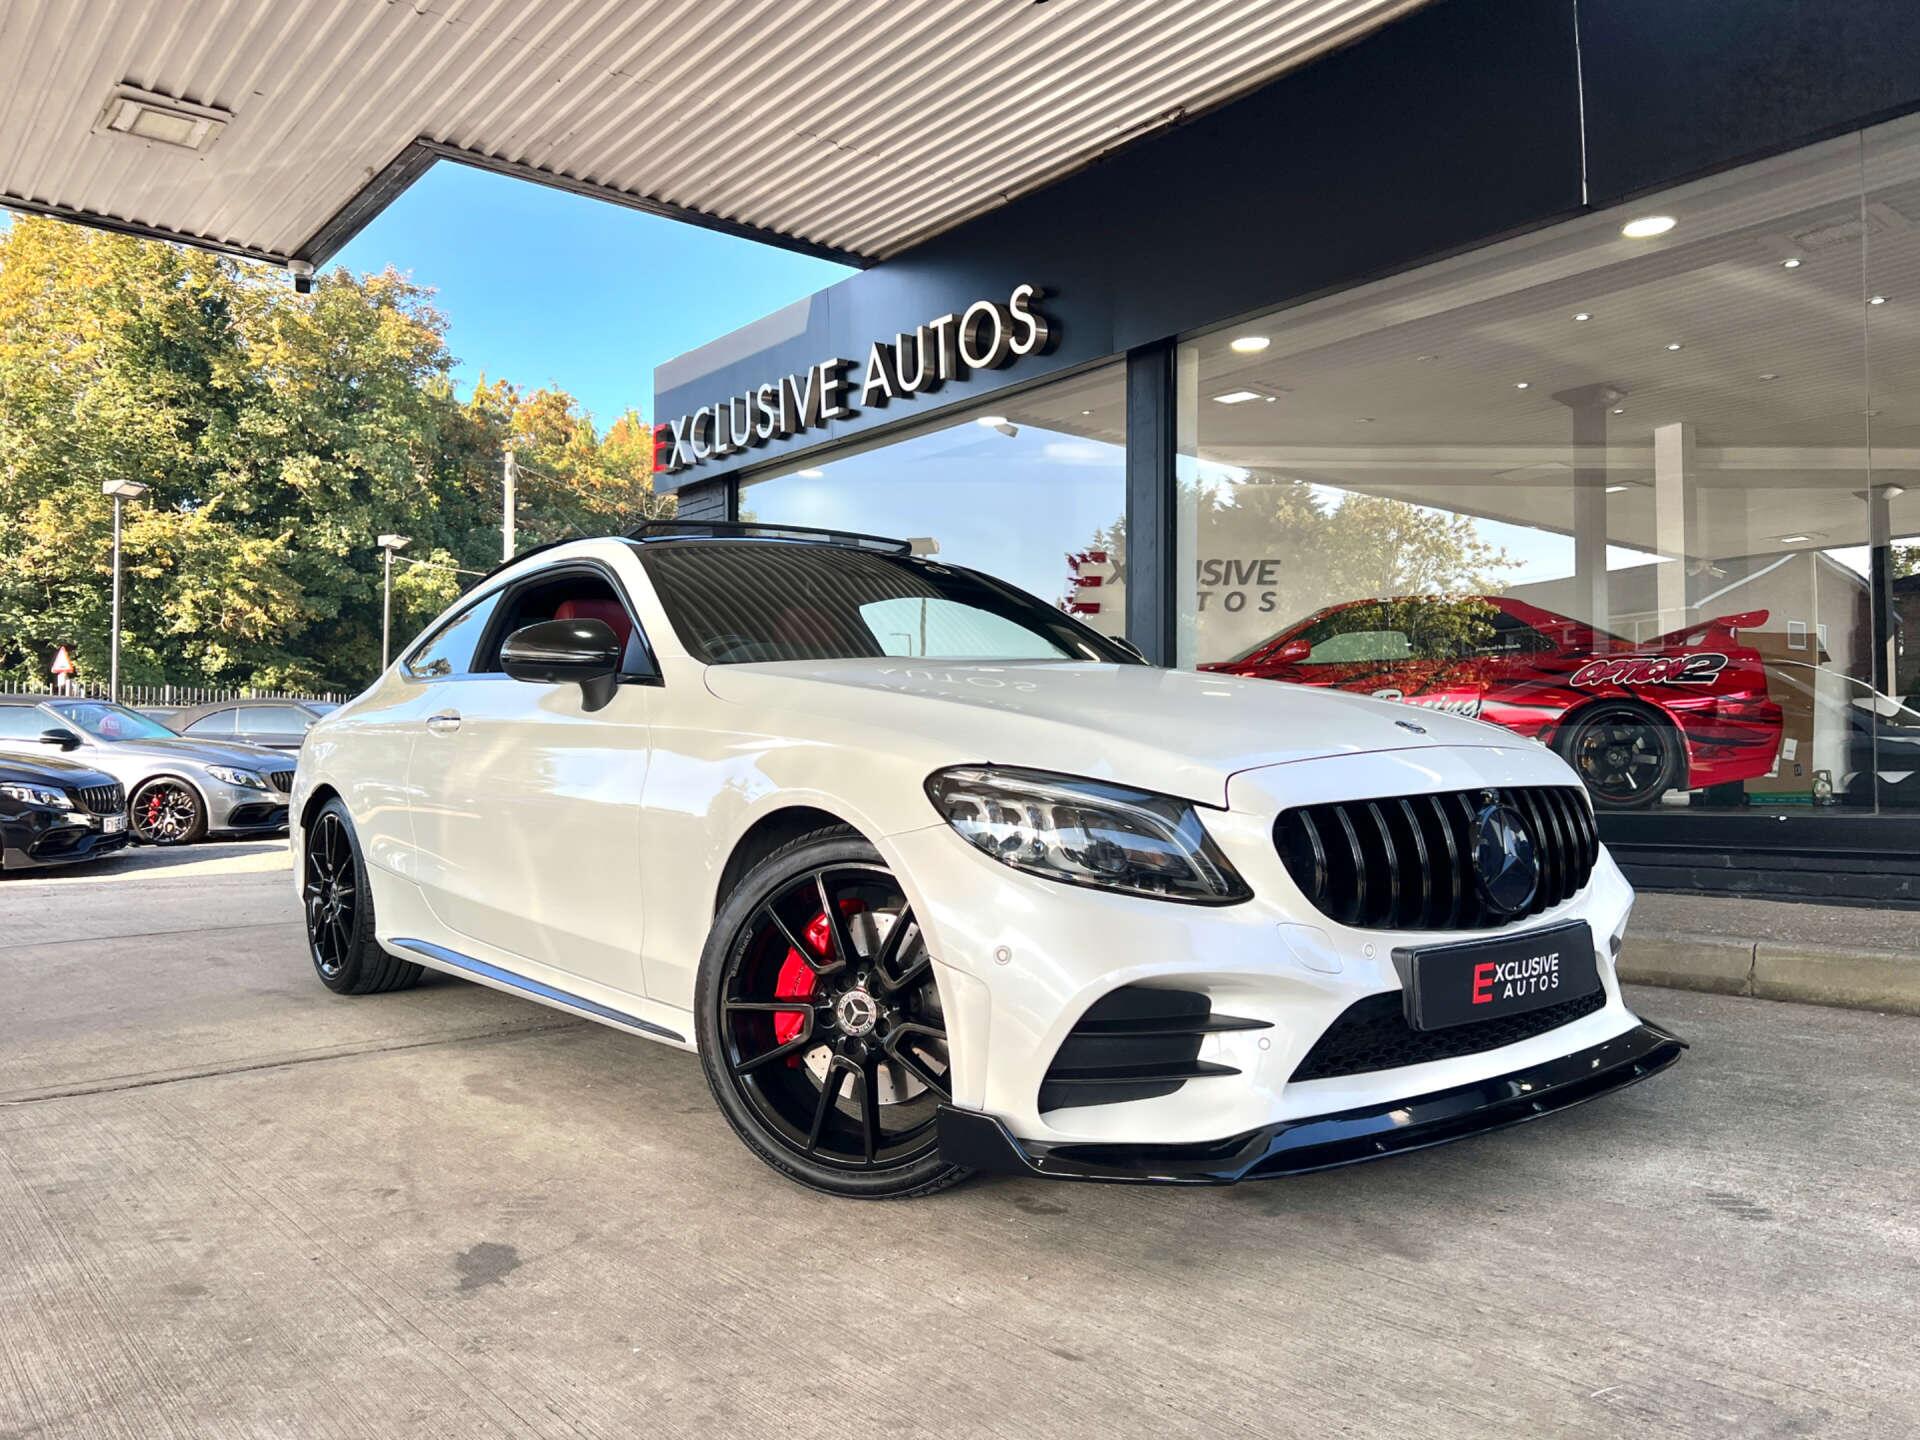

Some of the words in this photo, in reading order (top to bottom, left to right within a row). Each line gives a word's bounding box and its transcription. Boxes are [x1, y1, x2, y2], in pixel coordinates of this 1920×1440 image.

[653, 357, 841, 472] EXCLUSIVE
[861, 283, 1038, 406] AUTOS
[1196, 591, 1277, 613] TOS
[1472, 952, 1559, 1004] EXCLUSIVE
[1503, 972, 1559, 999] AUTOS
